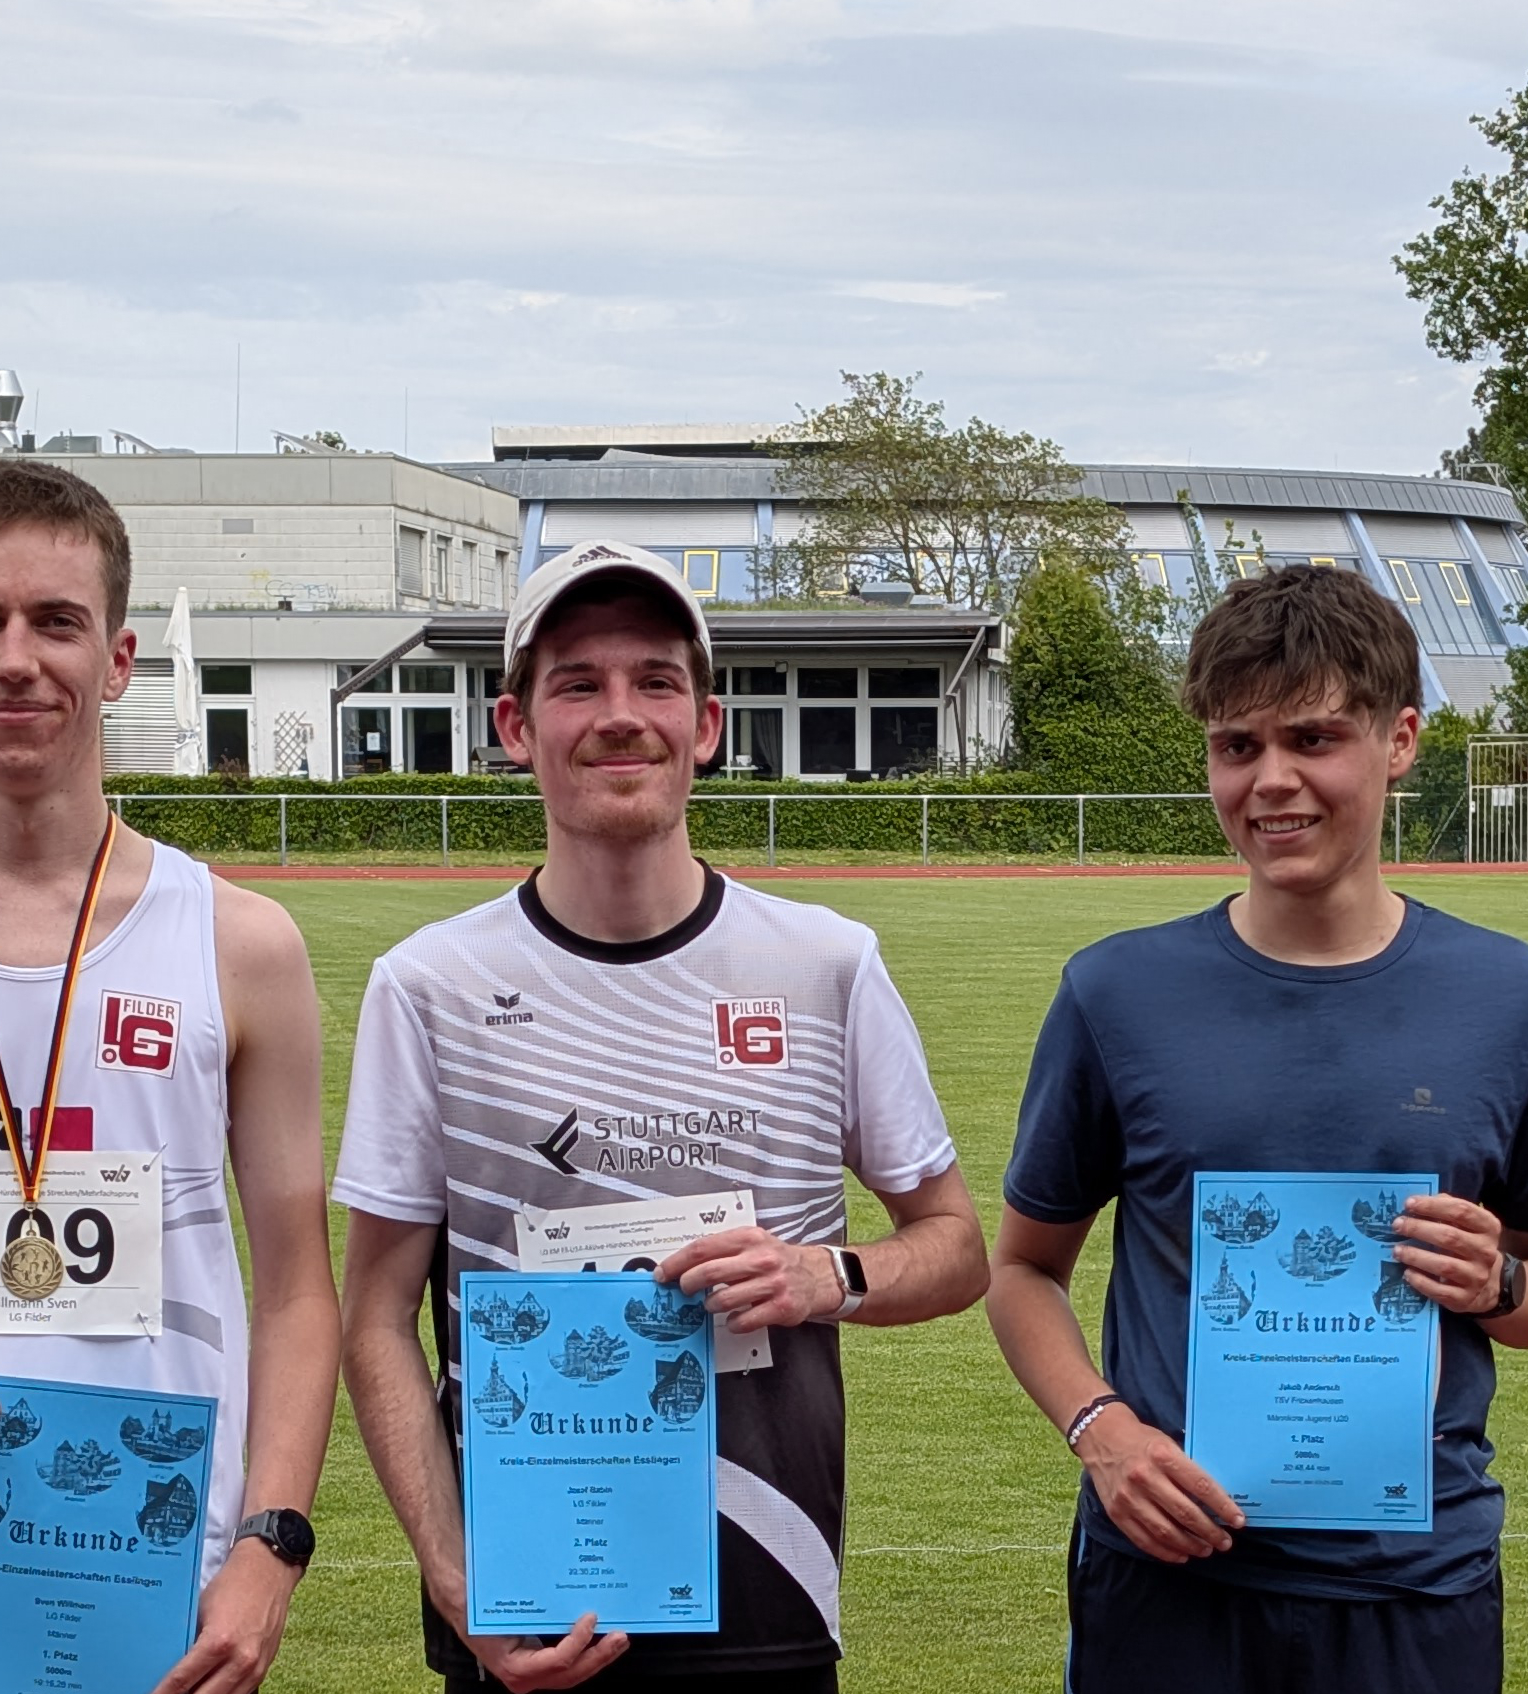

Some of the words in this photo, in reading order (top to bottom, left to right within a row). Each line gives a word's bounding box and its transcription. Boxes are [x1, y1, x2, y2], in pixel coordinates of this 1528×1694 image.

[123, 998, 175, 1020] FILDER
[732, 1001, 781, 1015] FILDER
[485, 1012, 533, 1026] erima
[594, 1109, 761, 1141] STUTTGART
[596, 1142, 722, 1173] AIRPORT
[47, 1298, 77, 1309] Sven
[9, 1313, 22, 1322] LG
[1255, 1309, 1377, 1334] Urkunde
[529, 1411, 654, 1435] Urkunde
[1301, 1434, 1324, 1443] Platz
[9, 1519, 139, 1554] Urkunde
[585, 1538, 608, 1547] Platz
[42, 1650, 51, 1659] 1.
[53, 1650, 78, 1661] Platz
